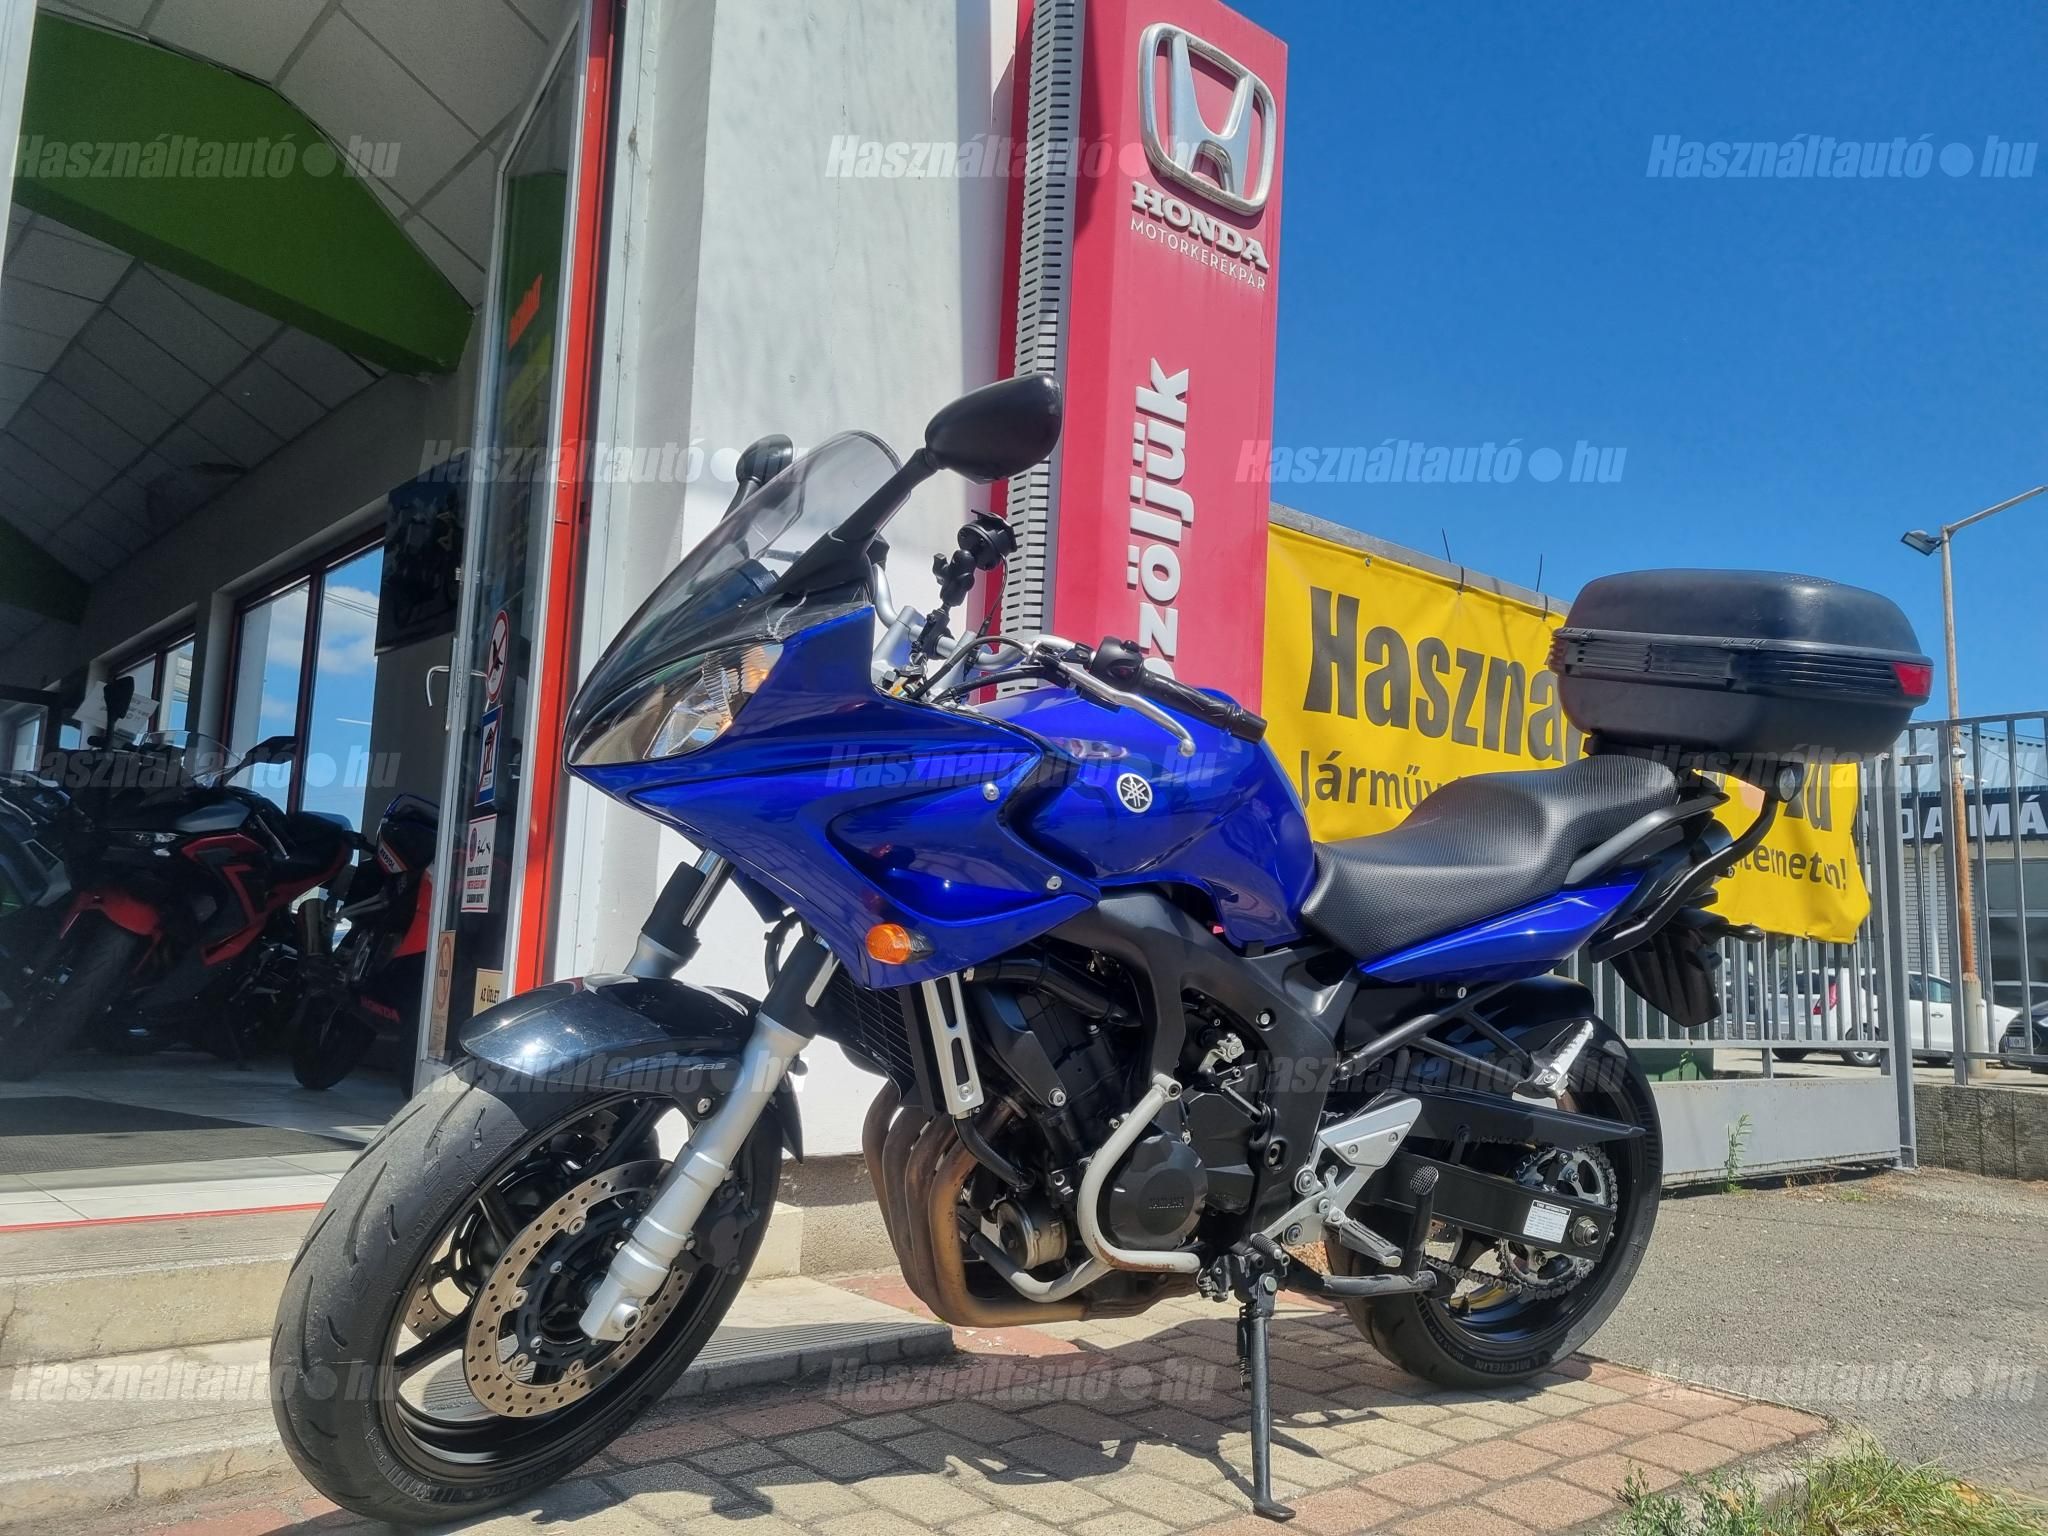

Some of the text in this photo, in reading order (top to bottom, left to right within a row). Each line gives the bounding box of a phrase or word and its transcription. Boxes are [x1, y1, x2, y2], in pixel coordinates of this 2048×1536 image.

[1130, 217, 1267, 291] MOTORKERÉKPÁR
[1131, 181, 1270, 269] HONDA
[1302, 585, 1584, 766] Haszná
